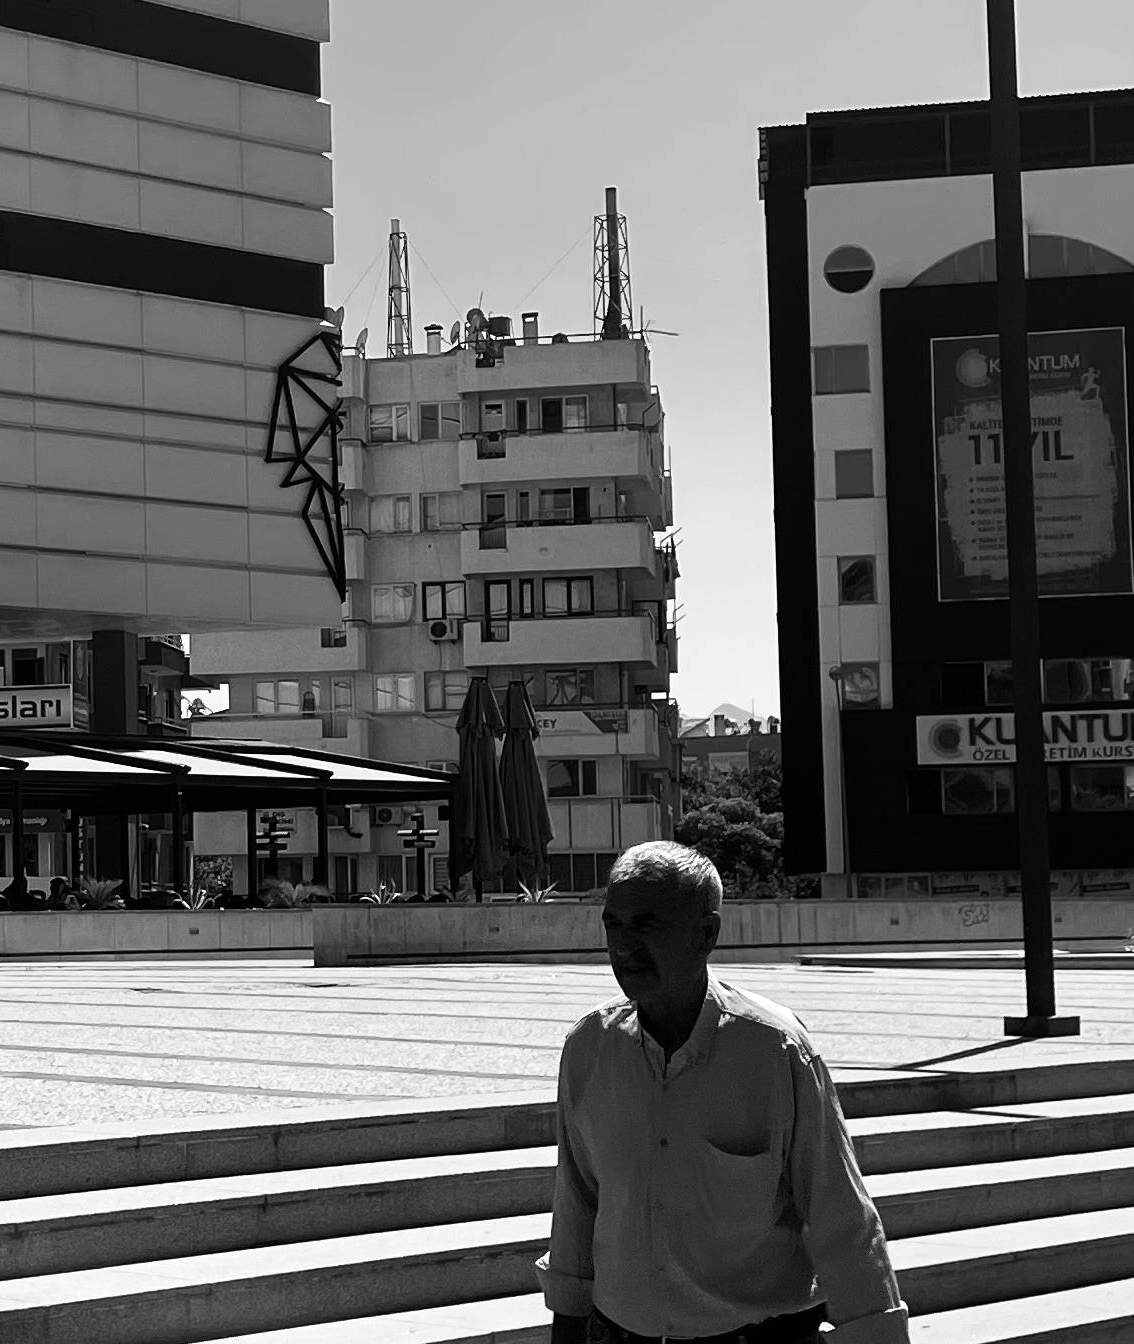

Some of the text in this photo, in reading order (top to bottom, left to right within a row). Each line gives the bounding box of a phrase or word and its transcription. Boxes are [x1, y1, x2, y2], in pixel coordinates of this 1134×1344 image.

[989, 353, 1080, 373] KNTUM
[969, 713, 1134, 746] KUNTU
[972, 748, 1010, 761] ÖZEL
